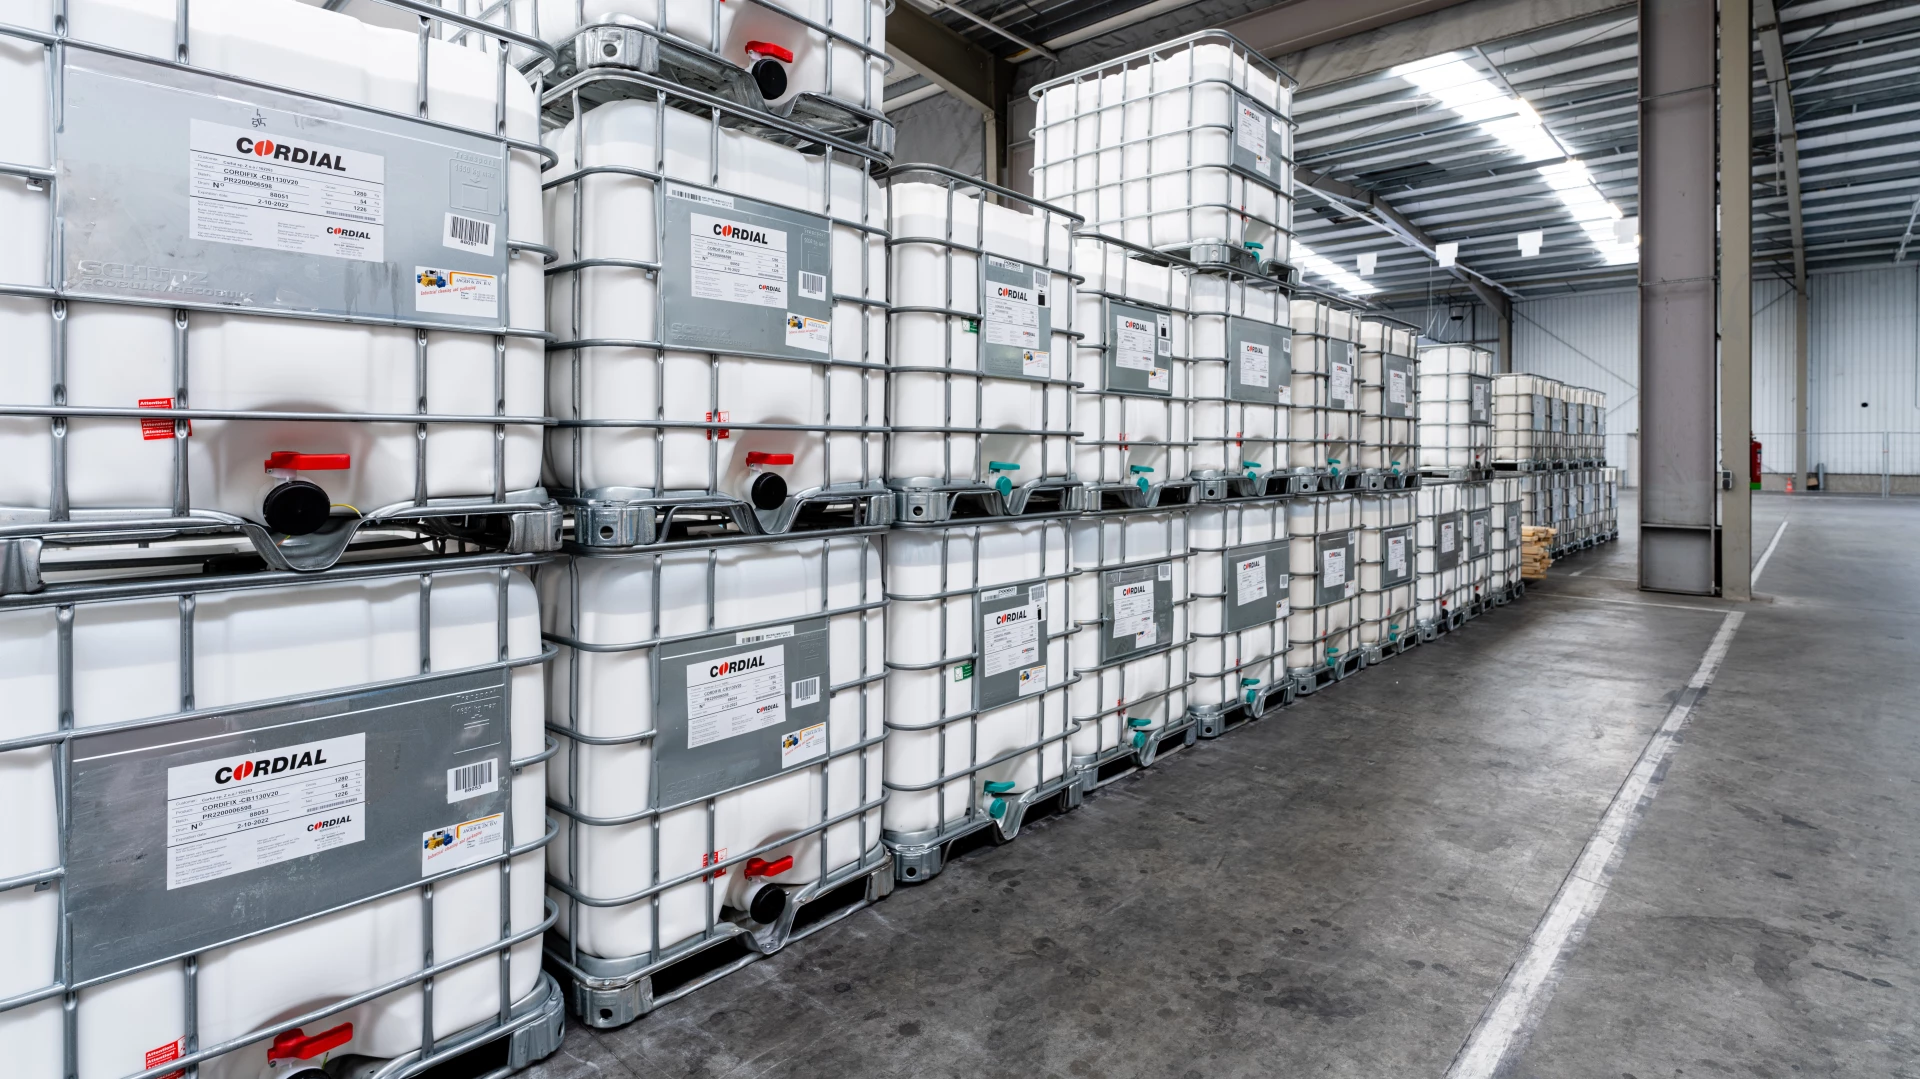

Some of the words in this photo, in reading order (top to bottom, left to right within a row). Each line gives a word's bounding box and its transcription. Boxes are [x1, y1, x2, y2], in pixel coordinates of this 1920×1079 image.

[236, 137, 346, 171] CORDIAL
[223, 168, 257, 178] CORDIFIX
[258, 198, 289, 208] 2-10-2022
[326, 226, 371, 239] CORDIAL
[713, 223, 768, 245] CORDIAL
[758, 284, 781, 293] CORDIAL
[998, 287, 1028, 302] CORDIAL
[1125, 320, 1147, 331] CORDIAL
[1122, 585, 1145, 596] CORDIAL
[996, 610, 1027, 625] CORDIAL
[710, 655, 765, 678] CORDIAL
[756, 703, 779, 714] CORDIAL
[215, 749, 327, 784] CORDIAL
[202, 799, 237, 811] CORDIFIX
[202, 804, 252, 819] PR2200006598
[249, 809, 269, 817] 88053
[237, 817, 269, 829] 2-10-2022
[307, 815, 352, 832] CORDIAL
